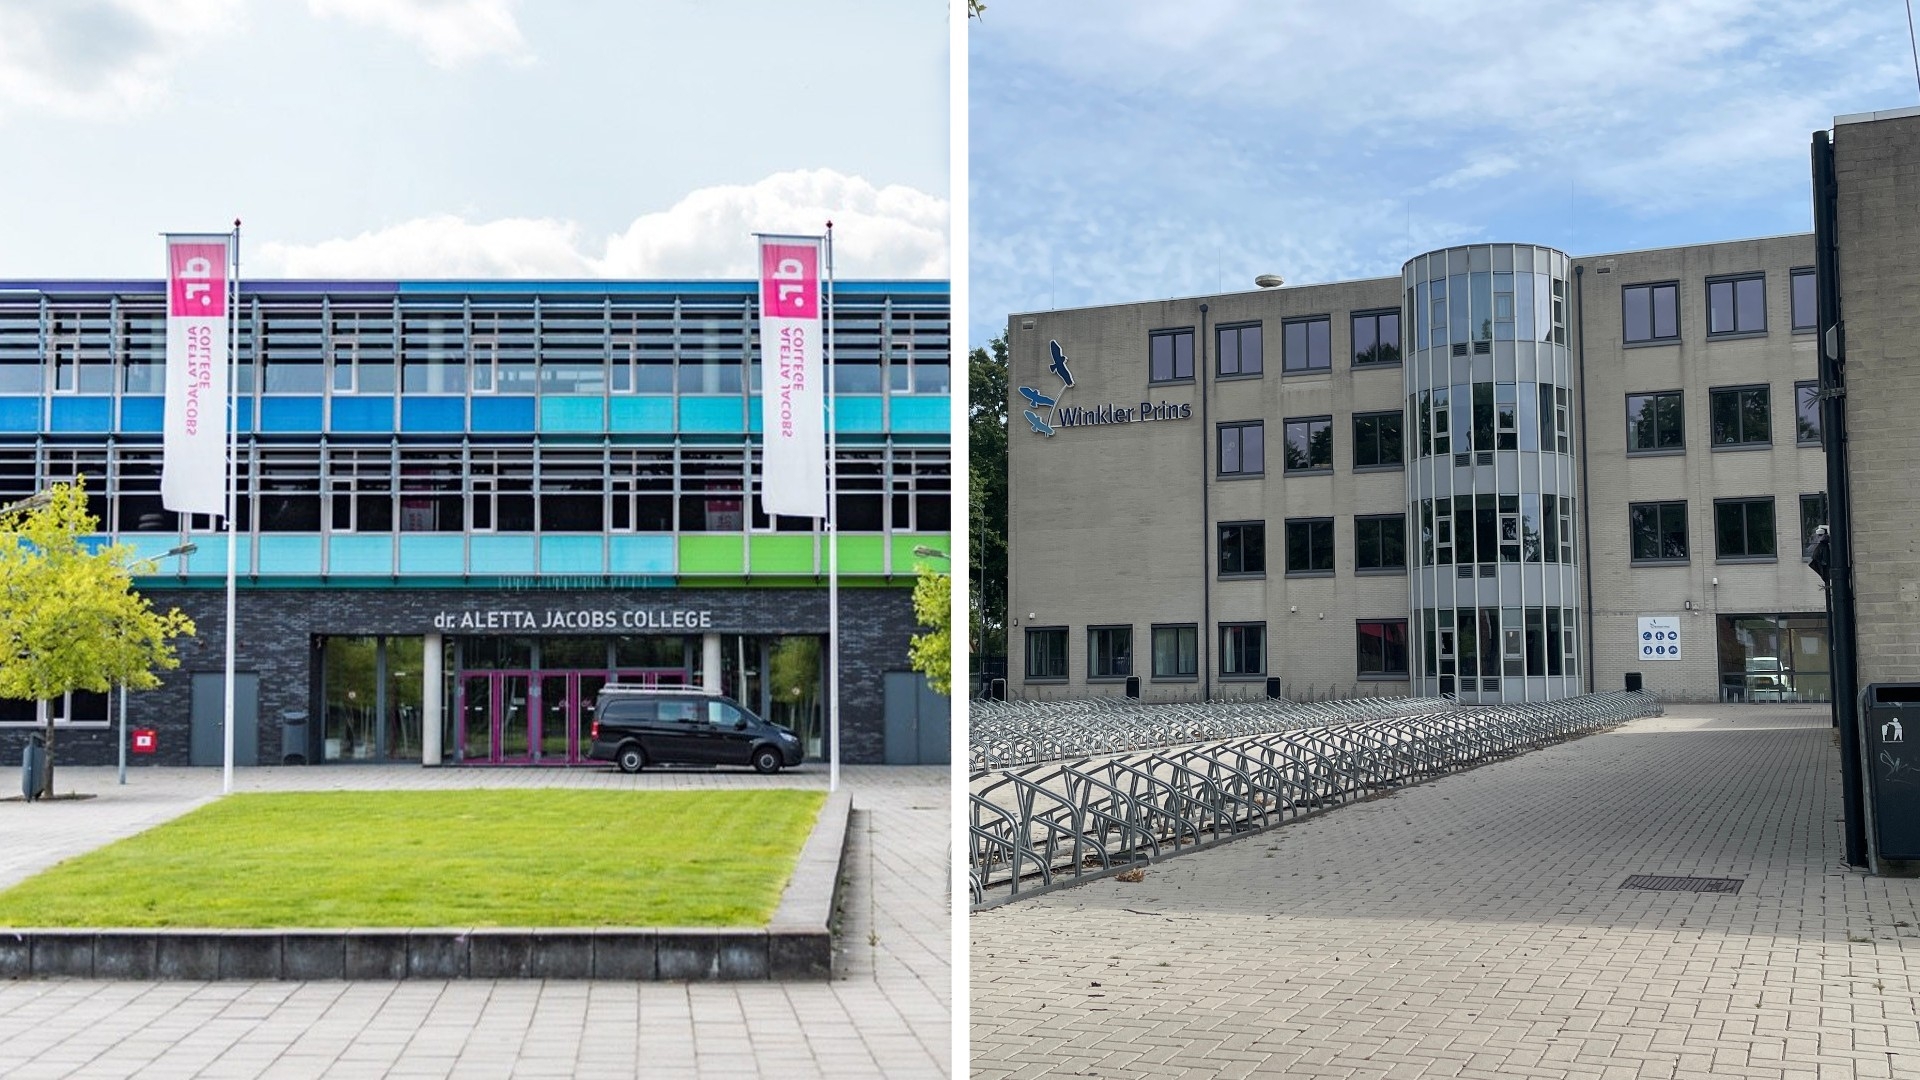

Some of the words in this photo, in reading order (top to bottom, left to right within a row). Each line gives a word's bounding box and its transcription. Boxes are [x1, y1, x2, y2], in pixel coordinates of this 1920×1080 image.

[1059, 403, 1135, 427] Winkler
[1140, 401, 1193, 422] Prins
[434, 611, 455, 628] dr.
[460, 611, 537, 628] ALETTA
[541, 611, 617, 628] JACOBS
[622, 611, 712, 628] COLLEGE
